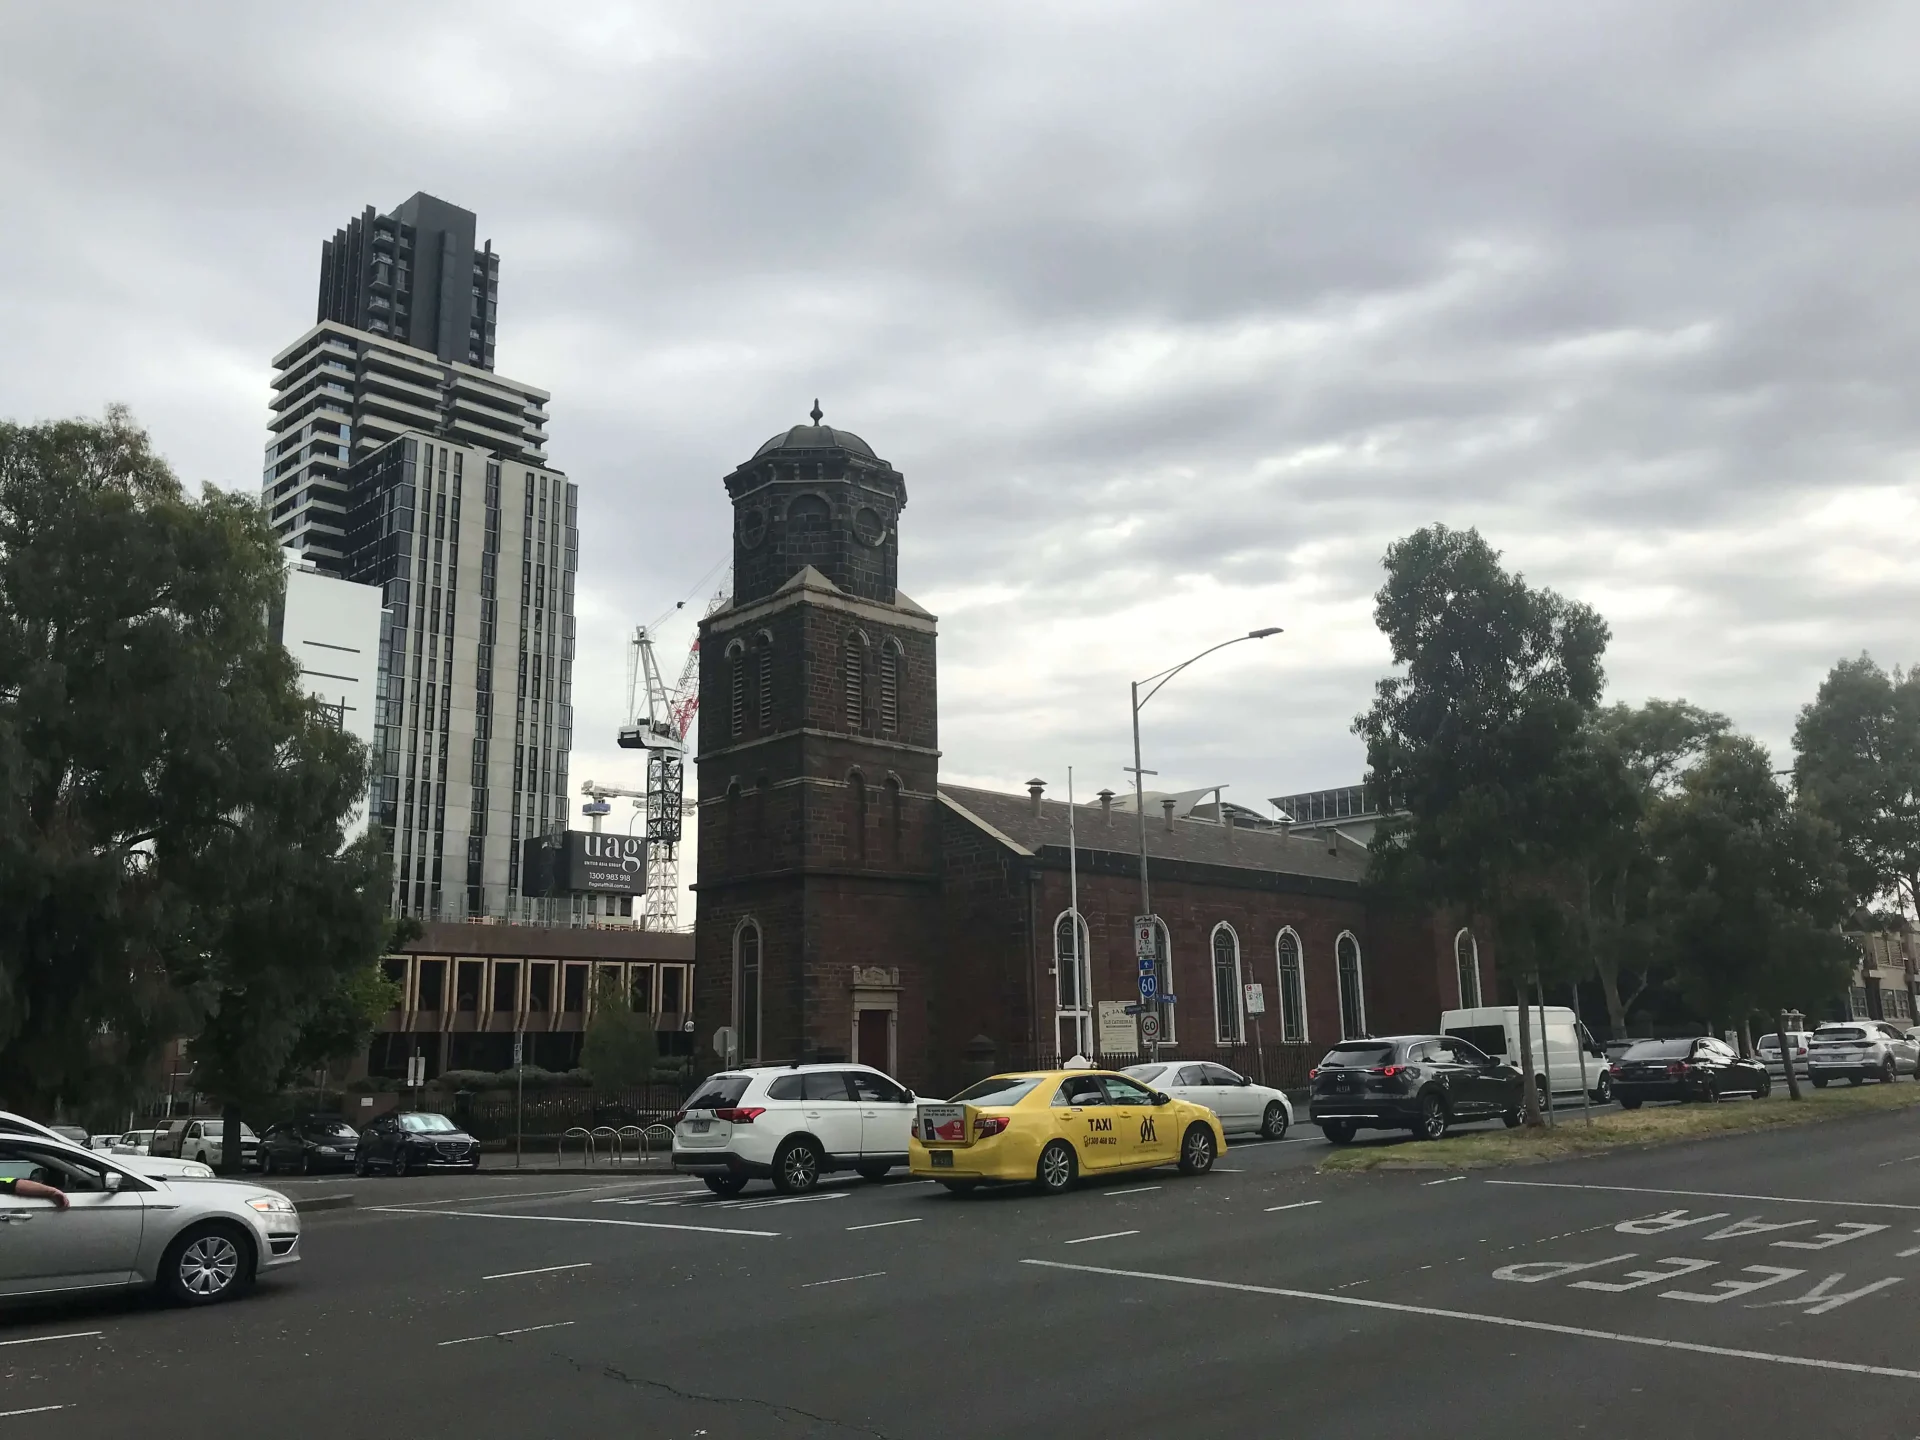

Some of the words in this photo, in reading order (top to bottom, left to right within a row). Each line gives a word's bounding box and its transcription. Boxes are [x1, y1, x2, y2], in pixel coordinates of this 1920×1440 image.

[584, 835, 641, 873] uag
[589, 872, 605, 880] 1300
[606, 873, 618, 881] 983
[620, 874, 631, 882] 918
[1141, 977, 1155, 992] 60
[1144, 1020, 1156, 1031] 60
[1088, 1118, 1112, 1131] TAXI
[1492, 1253, 1904, 1315] KEEP
